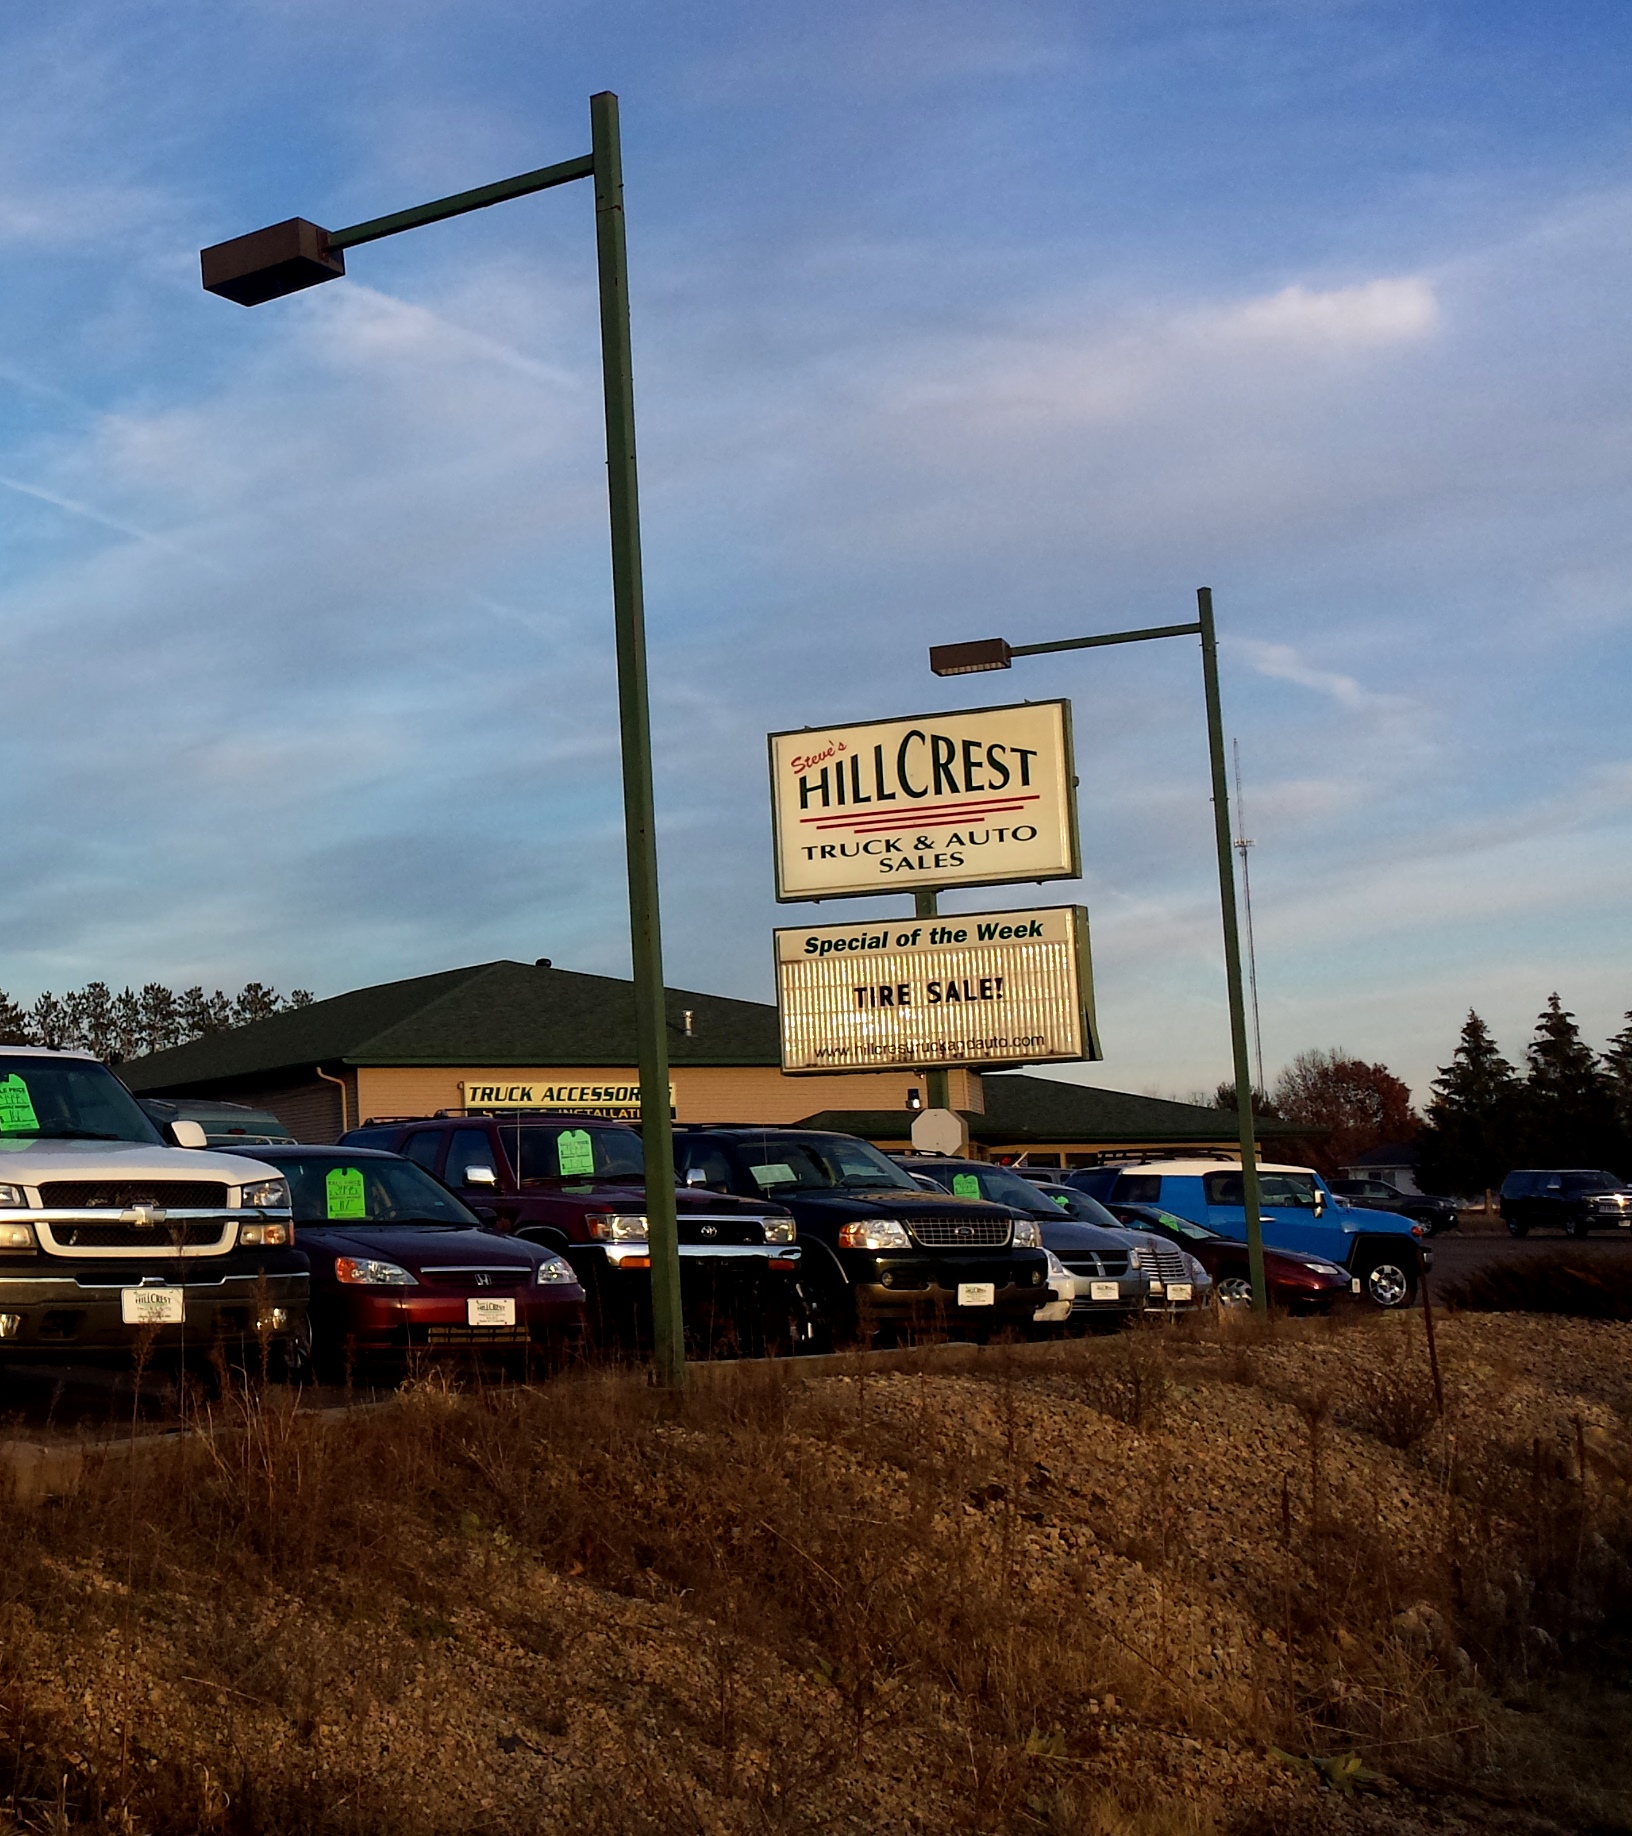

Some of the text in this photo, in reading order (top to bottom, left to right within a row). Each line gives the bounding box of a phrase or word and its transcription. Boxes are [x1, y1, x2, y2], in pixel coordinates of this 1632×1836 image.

[790, 740, 847, 775] Steve's
[801, 825, 1038, 861] TRUCK & AUTO
[879, 851, 965, 874] SALES
[804, 920, 1044, 957] Special of the Week
[854, 977, 1004, 1009] TIRE SALE!
[469, 1086, 673, 1102] TRUCK ACCESSOR
